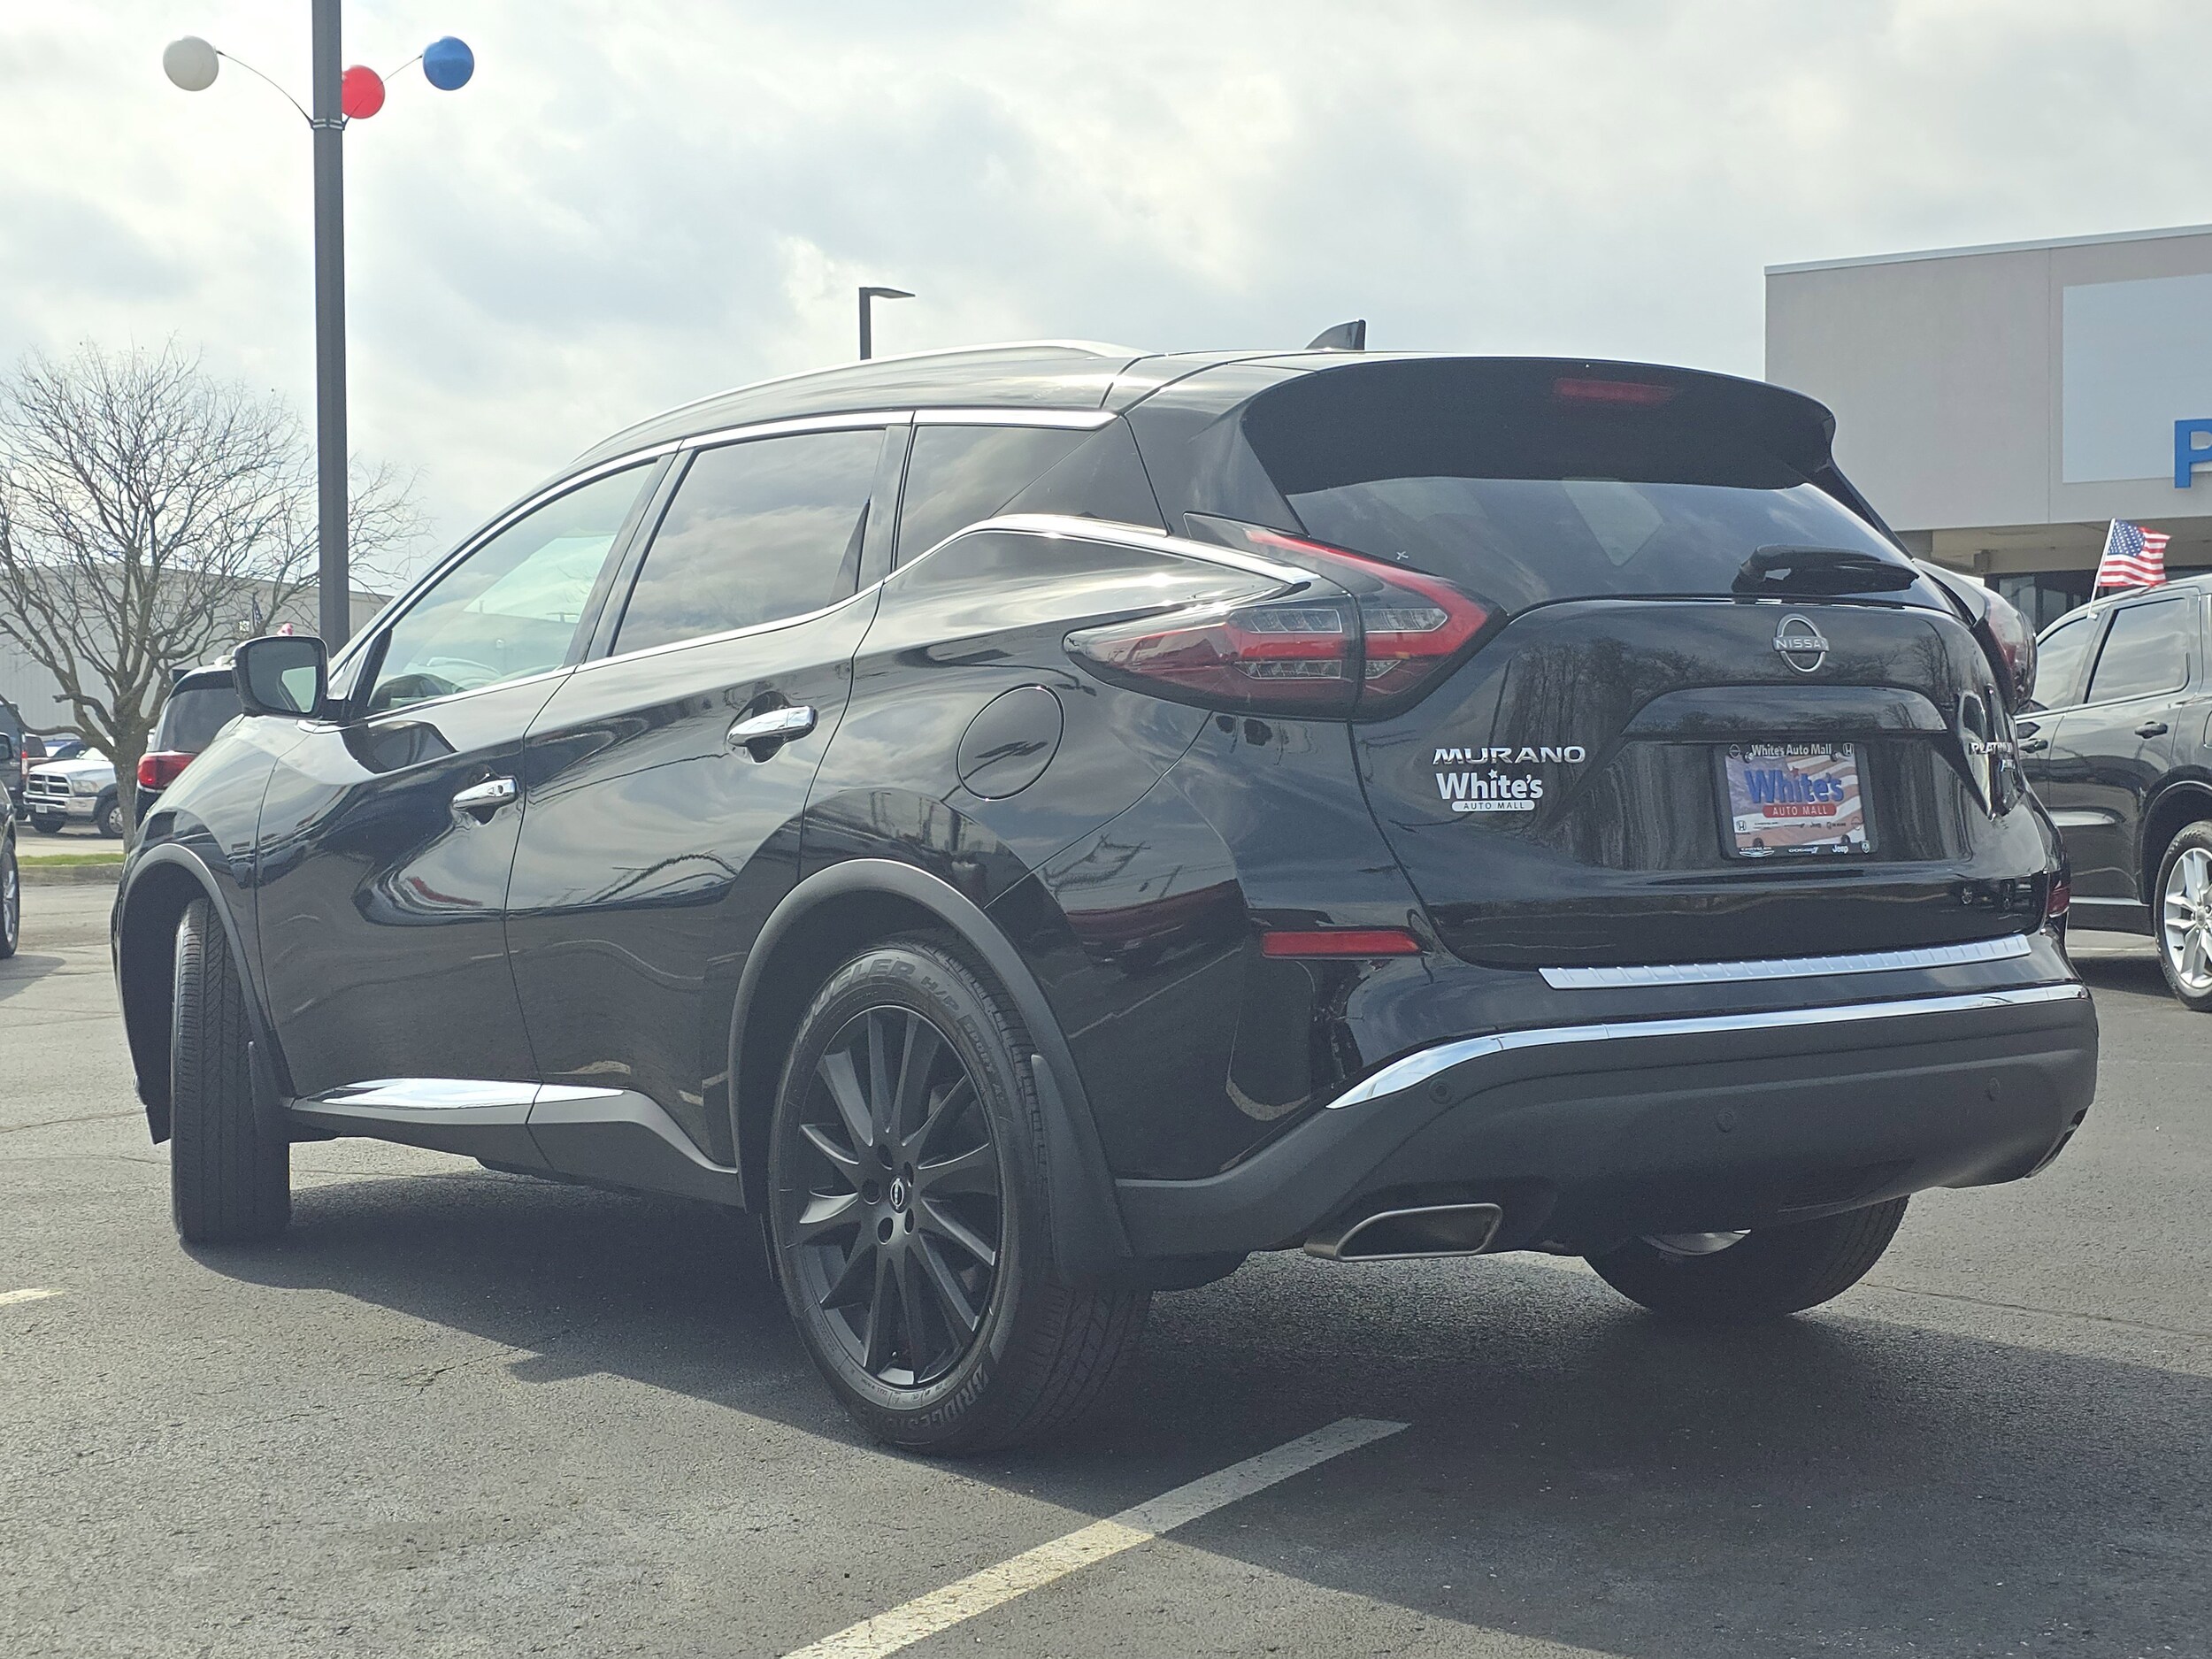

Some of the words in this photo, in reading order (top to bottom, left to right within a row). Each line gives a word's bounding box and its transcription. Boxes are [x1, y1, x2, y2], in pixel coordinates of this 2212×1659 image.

[1775, 639, 1829, 649] NISSAN
[1432, 746, 1586, 764] MURANO
[1751, 744, 1785, 757] White's
[1786, 744, 1808, 756] Auto
[1811, 743, 1832, 755] Mall
[1436, 769, 1543, 800] White's
[1744, 767, 1844, 803] White's
[1772, 807, 1798, 816] AUTO
[1802, 805, 1828, 815] MALL
[1832, 844, 1848, 854] Jeep
